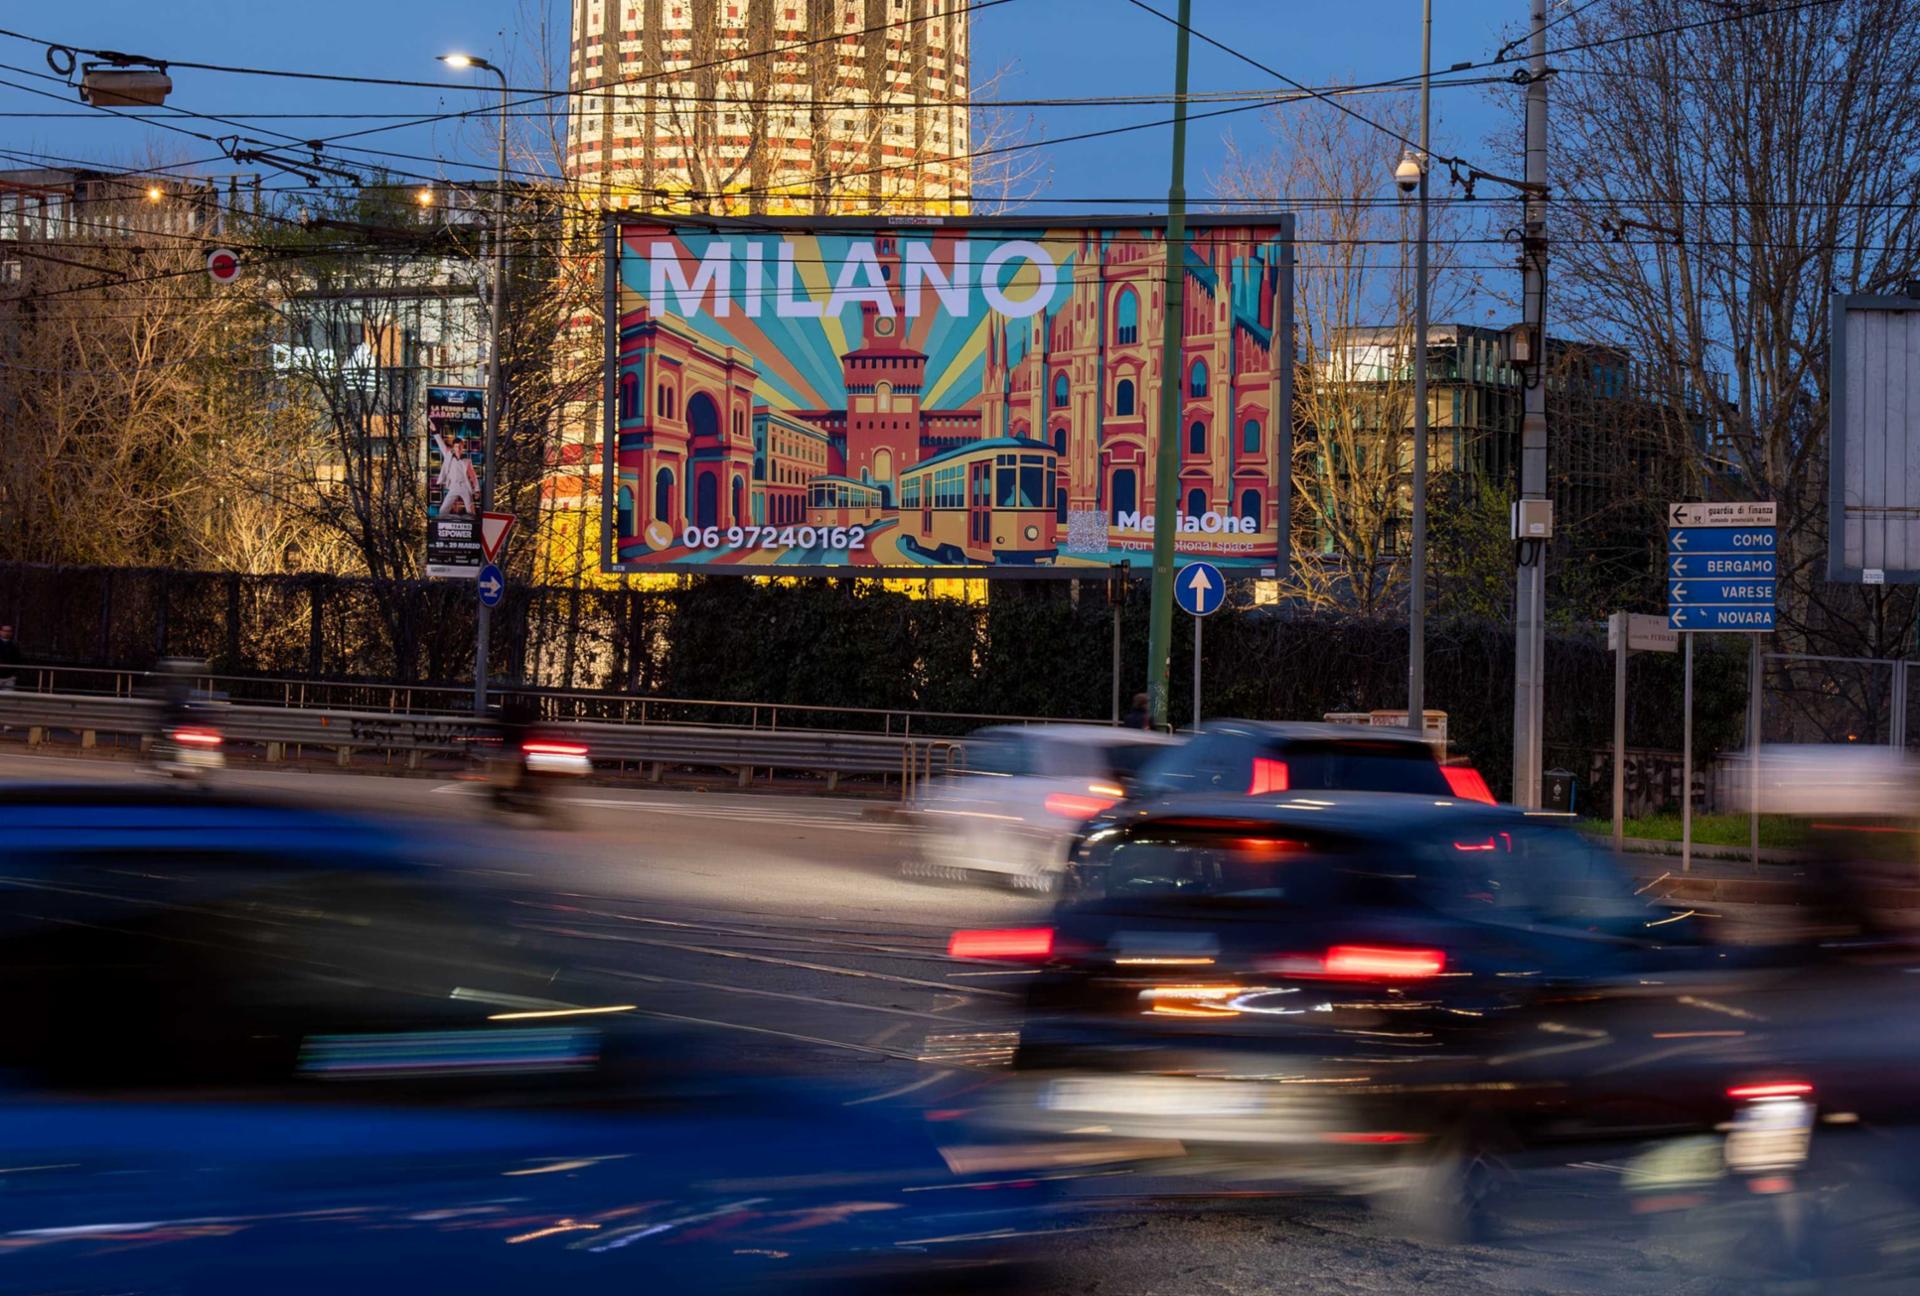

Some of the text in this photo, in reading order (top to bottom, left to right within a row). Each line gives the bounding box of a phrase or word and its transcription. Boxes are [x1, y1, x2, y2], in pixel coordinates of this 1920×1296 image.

[649, 240, 1057, 318] MILANO
[1708, 504, 1773, 516] guardia di finanza
[1118, 510, 1257, 533] MeiaOne
[682, 526, 865, 549] 06 97240162
[1732, 534, 1773, 546] COMO
[1120, 541, 1149, 553] your
[1216, 541, 1254, 553] space
[1707, 560, 1773, 573] BERGAMO
[1721, 586, 1773, 598] VARESE
[1717, 612, 1772, 624] NOVARA
